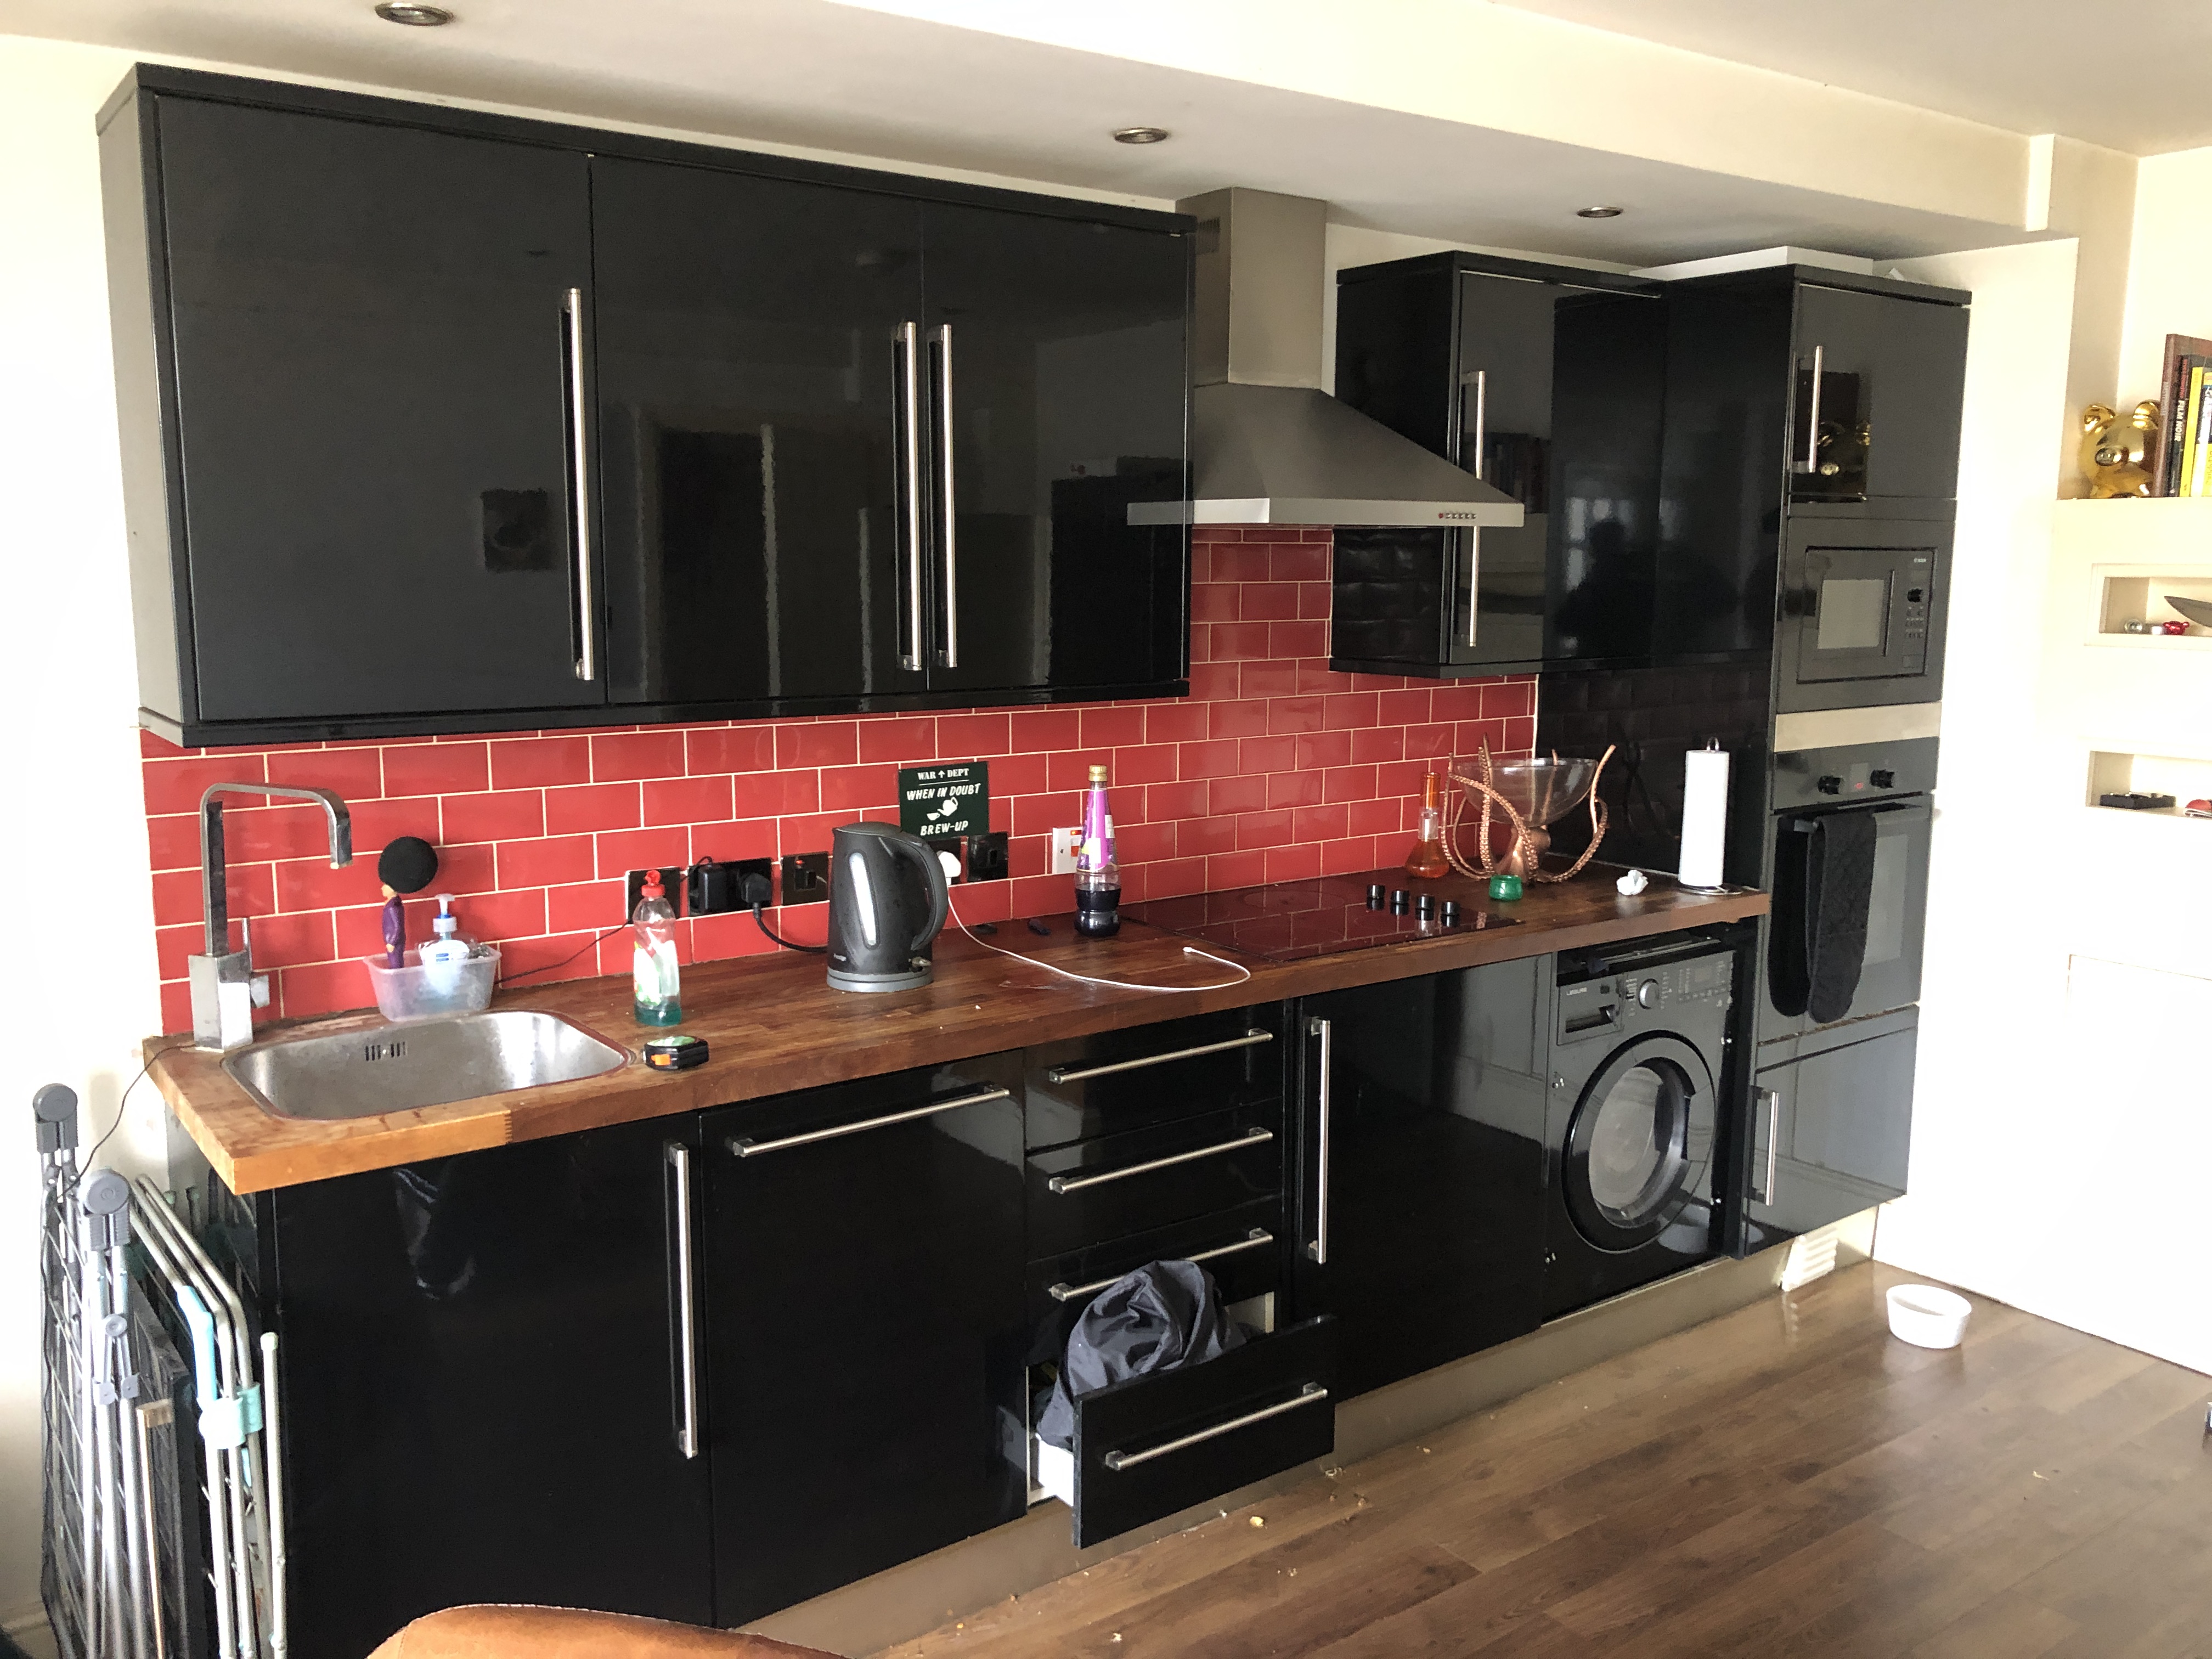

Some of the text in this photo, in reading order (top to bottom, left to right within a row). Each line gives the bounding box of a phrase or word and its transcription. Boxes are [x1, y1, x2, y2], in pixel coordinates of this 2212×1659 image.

[2176, 400, 2185, 420] FILM
[2174, 420, 2183, 442] NOIR
[917, 768, 969, 780] WAR DEPT
[906, 782, 981, 801] WHEN IN DOUBT
[920, 820, 969, 836] BREW-UP
